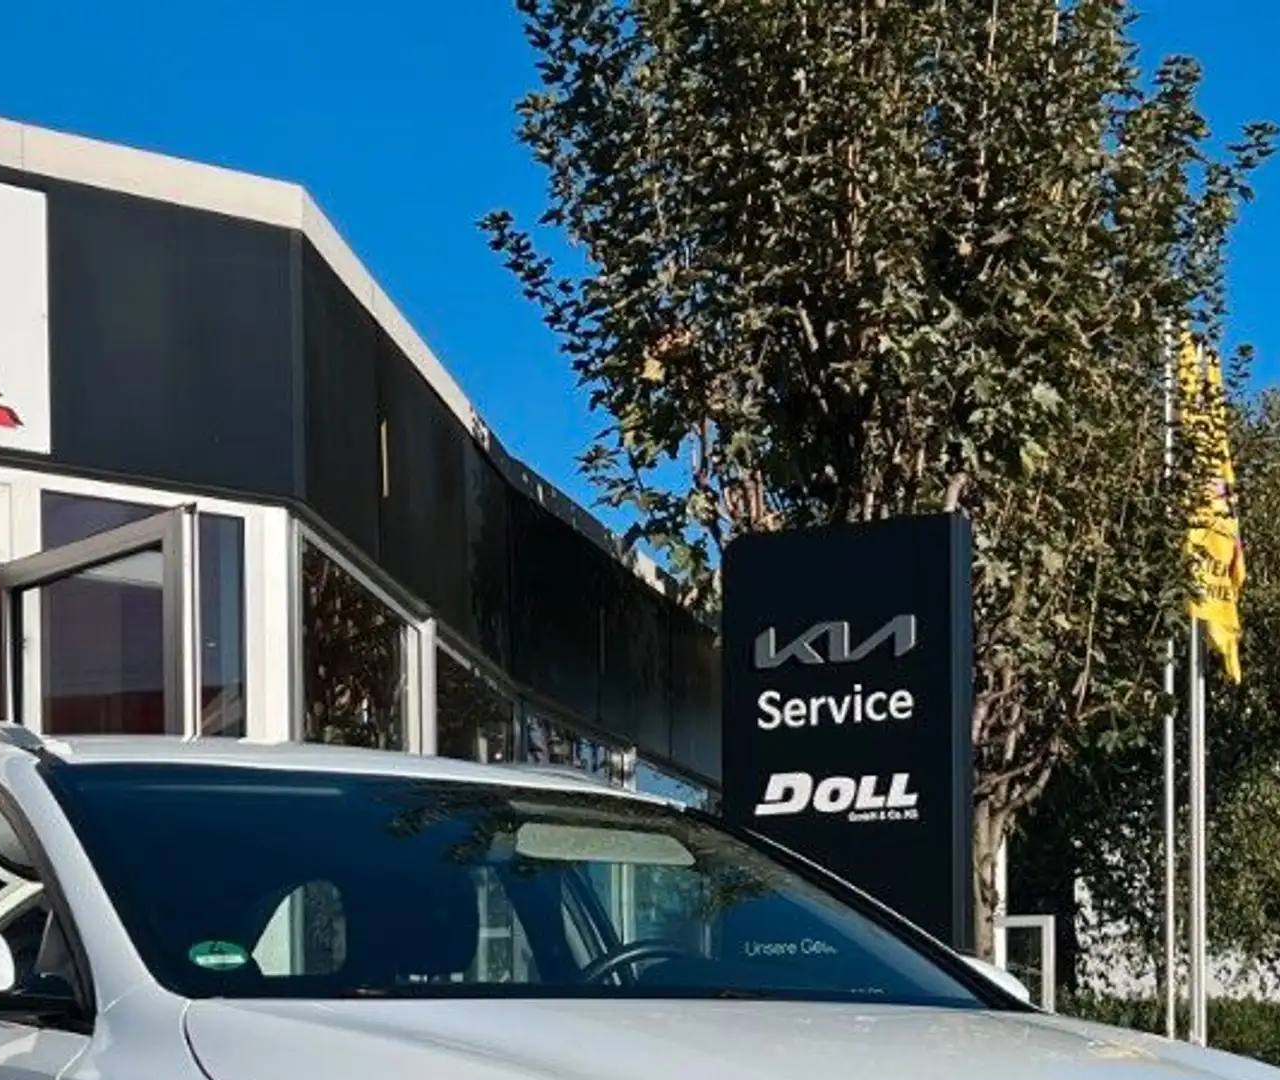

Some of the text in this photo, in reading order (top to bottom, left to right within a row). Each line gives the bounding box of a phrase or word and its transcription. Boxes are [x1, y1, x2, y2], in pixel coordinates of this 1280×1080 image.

[754, 614, 917, 669] KIA
[757, 684, 915, 730] Service
[754, 772, 919, 817] DOLL
